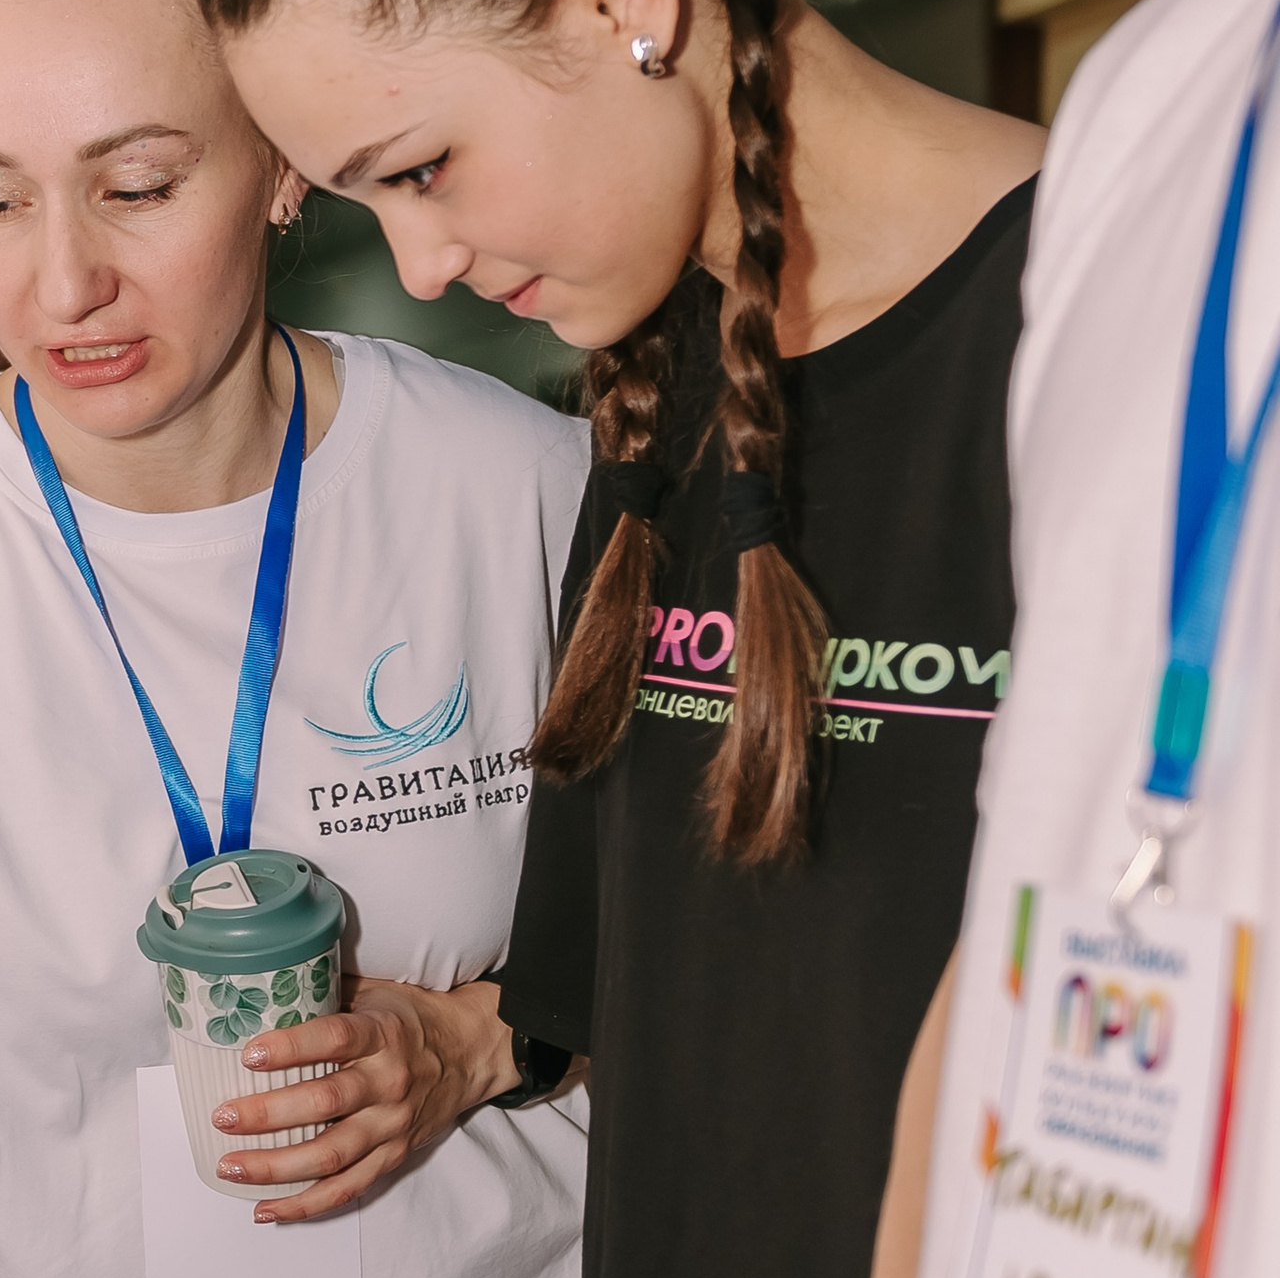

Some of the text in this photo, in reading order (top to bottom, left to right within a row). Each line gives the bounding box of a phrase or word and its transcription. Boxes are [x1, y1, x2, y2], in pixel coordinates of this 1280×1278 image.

[308, 747, 532, 811] ГРАВИТАЦИЯ
[319, 783, 529, 836] воздушный театр
